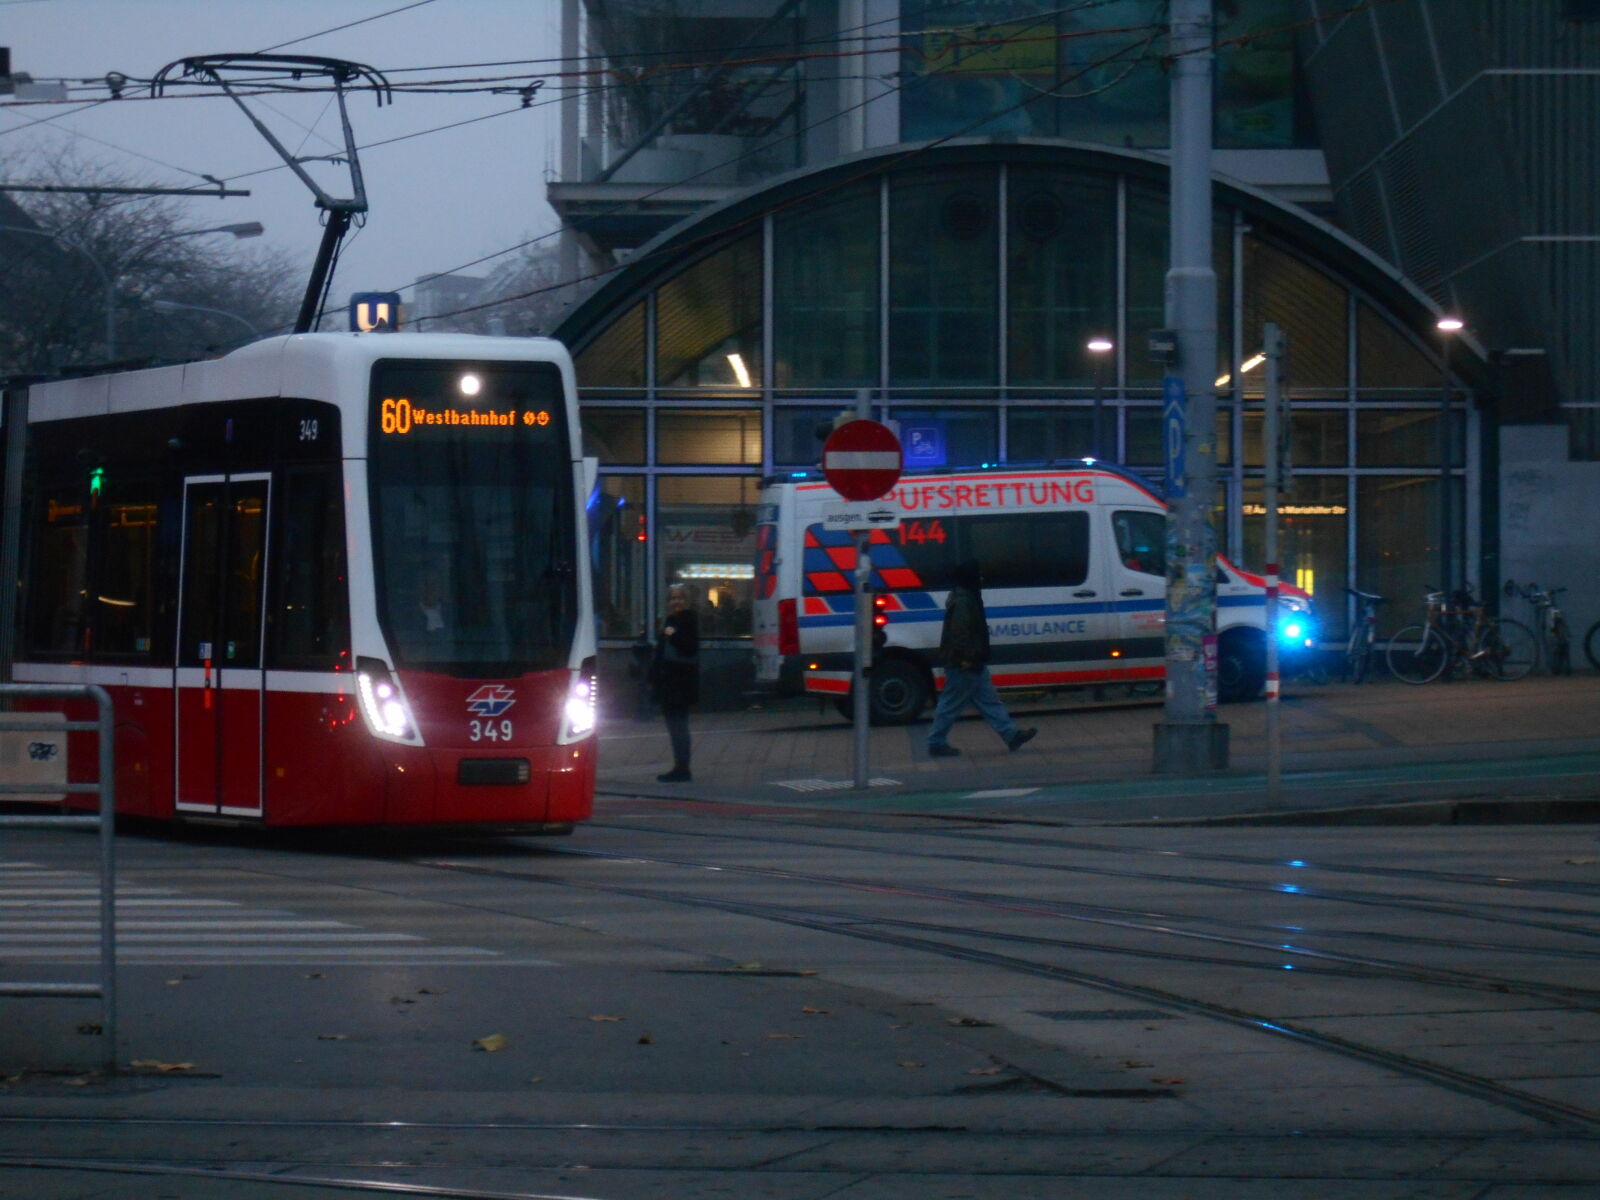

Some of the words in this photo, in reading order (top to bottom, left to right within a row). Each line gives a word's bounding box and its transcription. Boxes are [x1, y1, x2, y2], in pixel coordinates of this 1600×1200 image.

[357, 303, 389, 332] U
[381, 398, 411, 434] 60
[412, 409, 516, 426] Westbahnhof
[299, 419, 319, 441] 349
[912, 432, 922, 446] P
[898, 520, 947, 546] 144
[470, 720, 513, 742] 349
